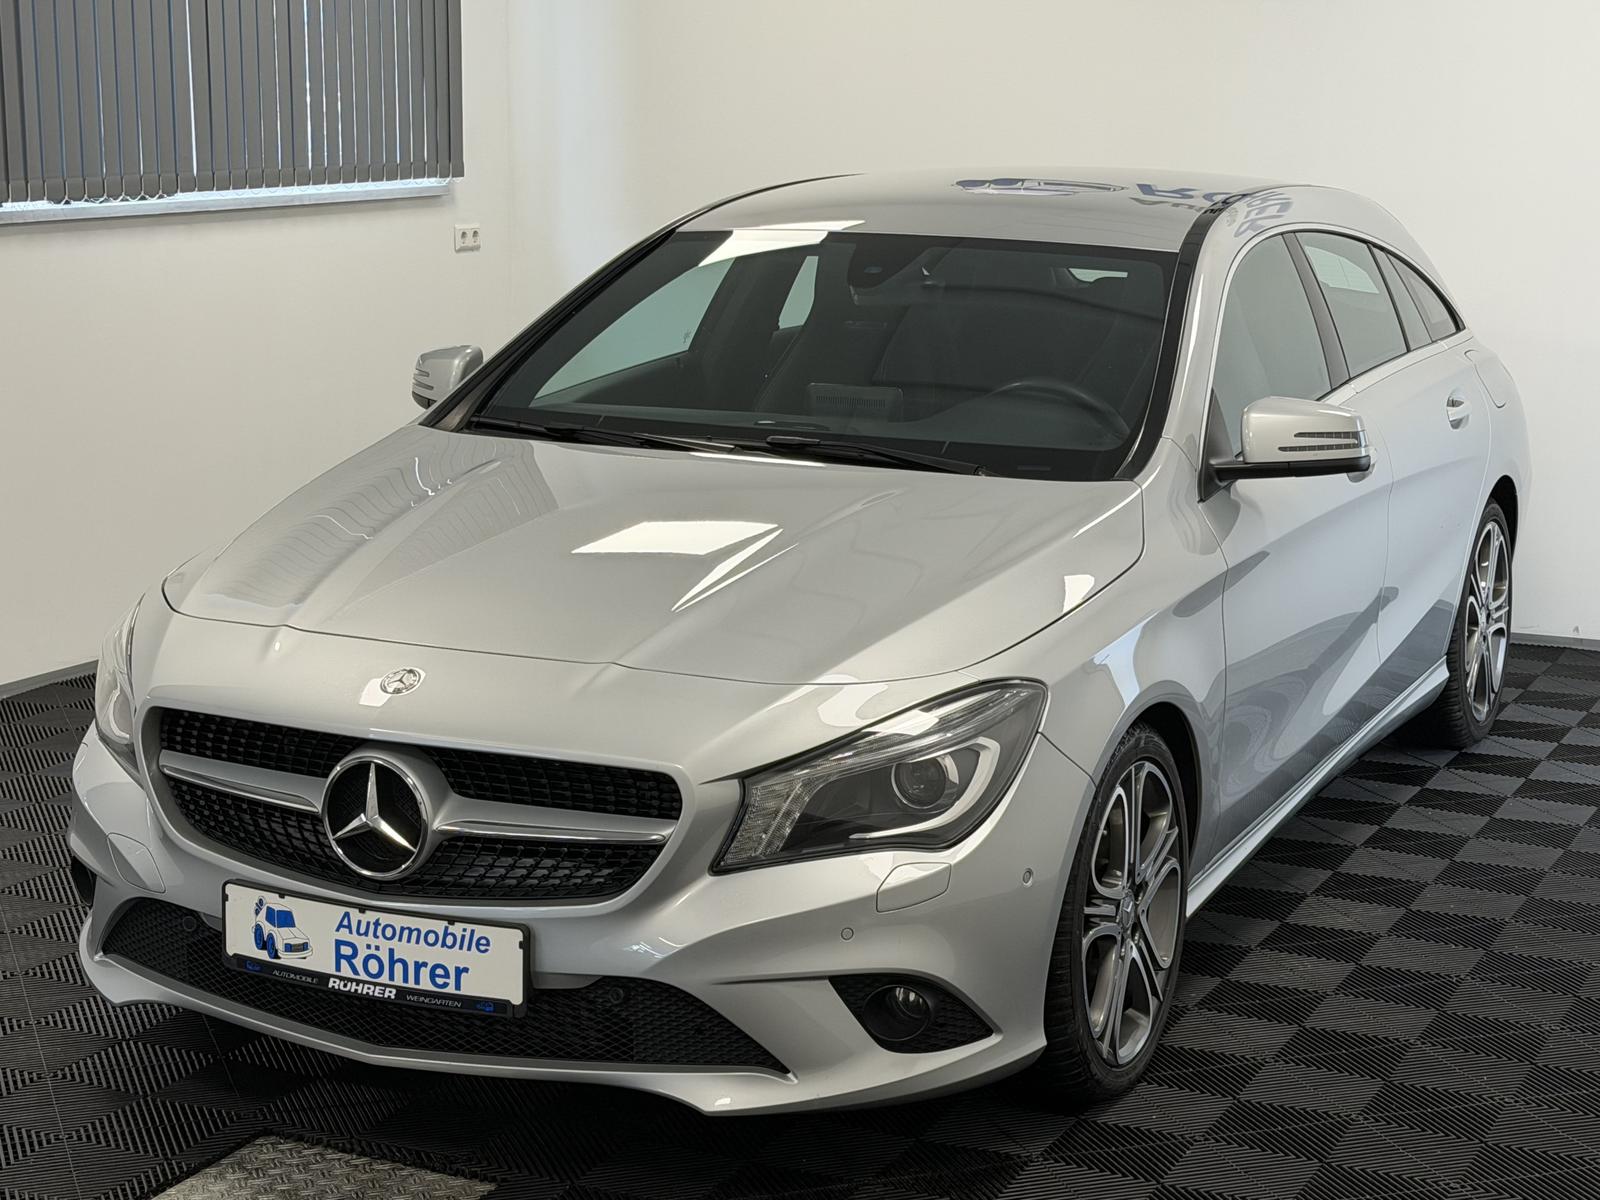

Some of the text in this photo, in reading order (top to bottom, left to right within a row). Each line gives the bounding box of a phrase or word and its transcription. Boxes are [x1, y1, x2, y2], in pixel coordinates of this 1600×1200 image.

[335, 911, 491, 954] Automobile
[334, 938, 470, 992] Röhrer
[272, 969, 319, 984] AUTOMOBILE
[406, 994, 462, 1008] WEINGARTEN
